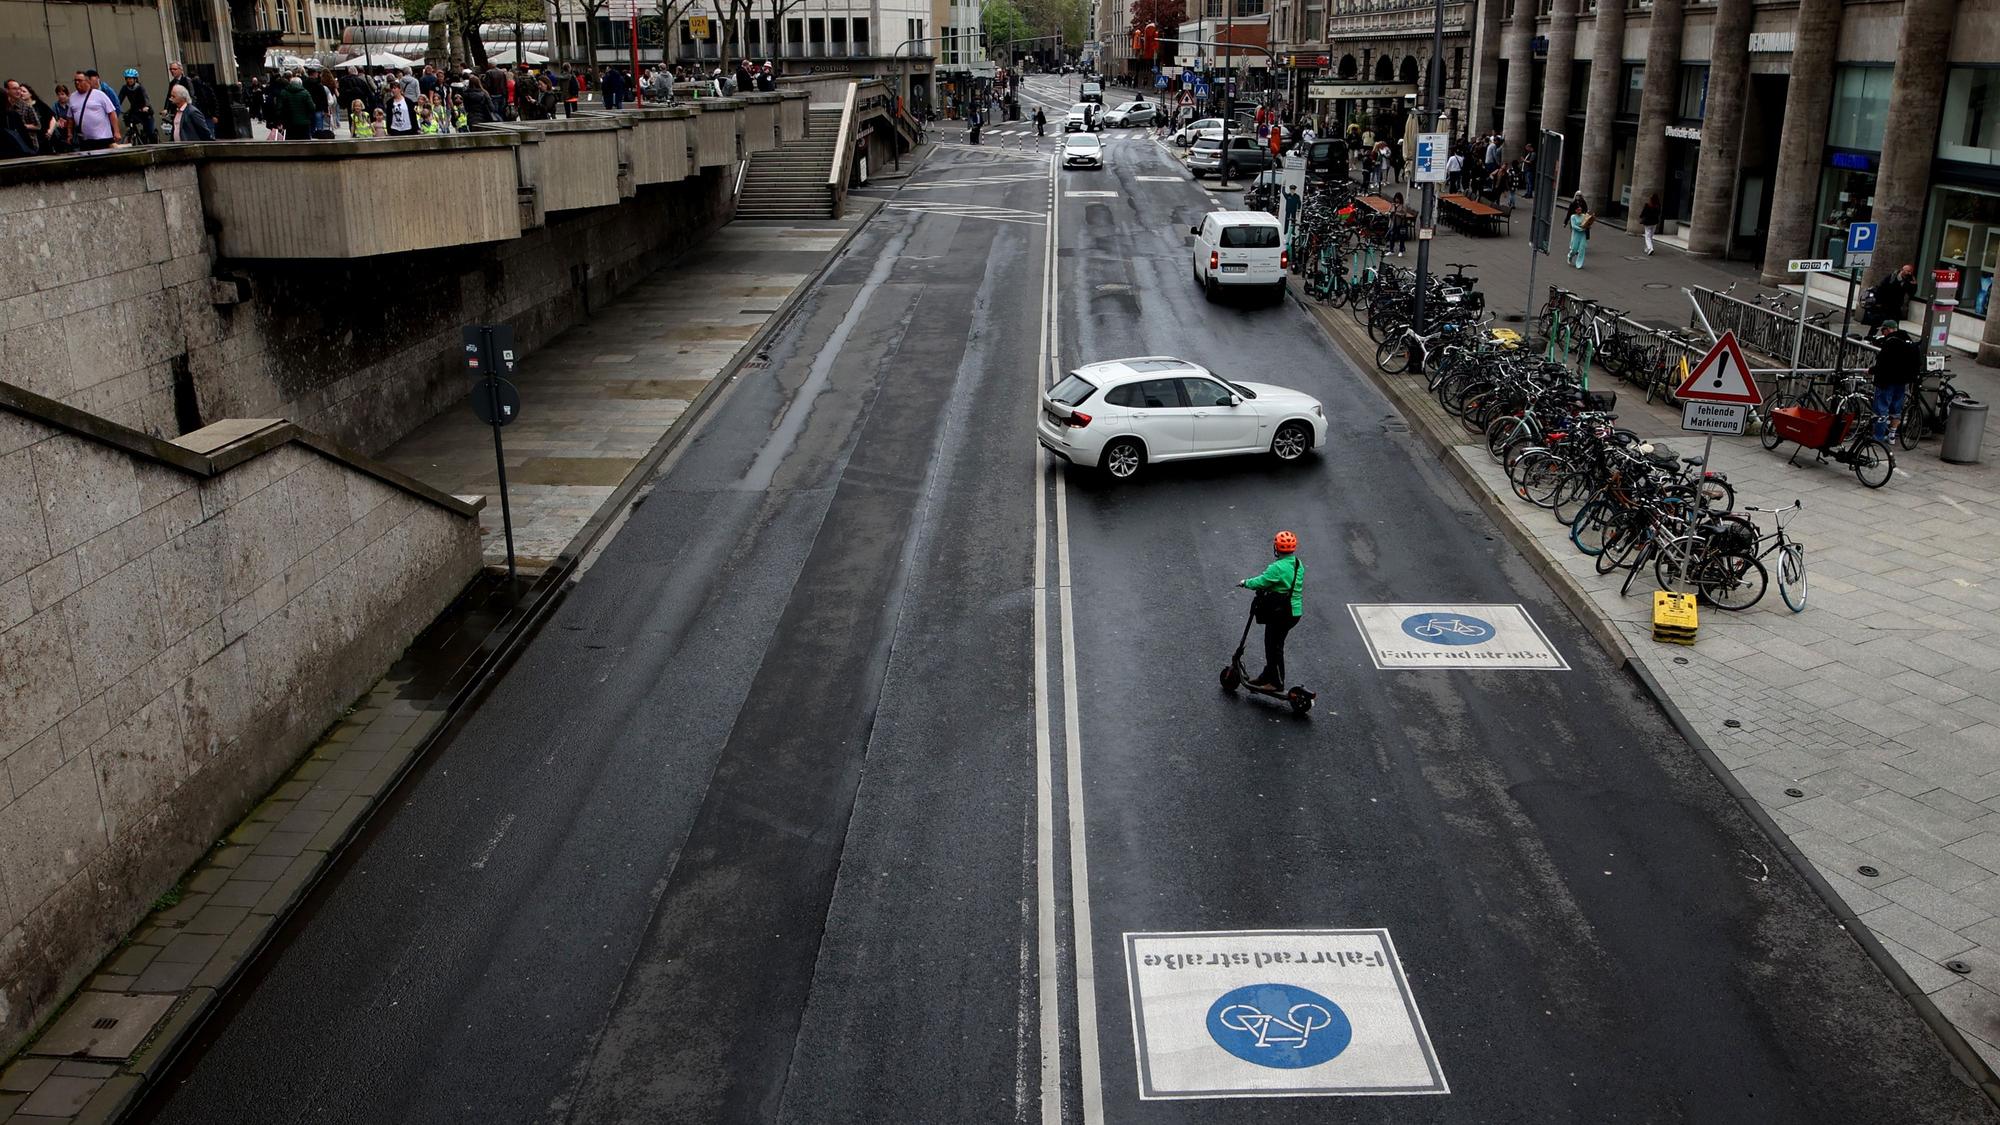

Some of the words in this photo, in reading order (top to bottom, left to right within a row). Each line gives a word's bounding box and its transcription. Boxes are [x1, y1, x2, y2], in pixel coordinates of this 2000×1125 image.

[1854, 226, 1871, 249] P
[1698, 405, 1735, 416] fehlende
[1690, 417, 1738, 431] Markierung
[1380, 650, 1548, 660] Fahrradstraße
[1144, 950, 1385, 970] Fahrradstraße
